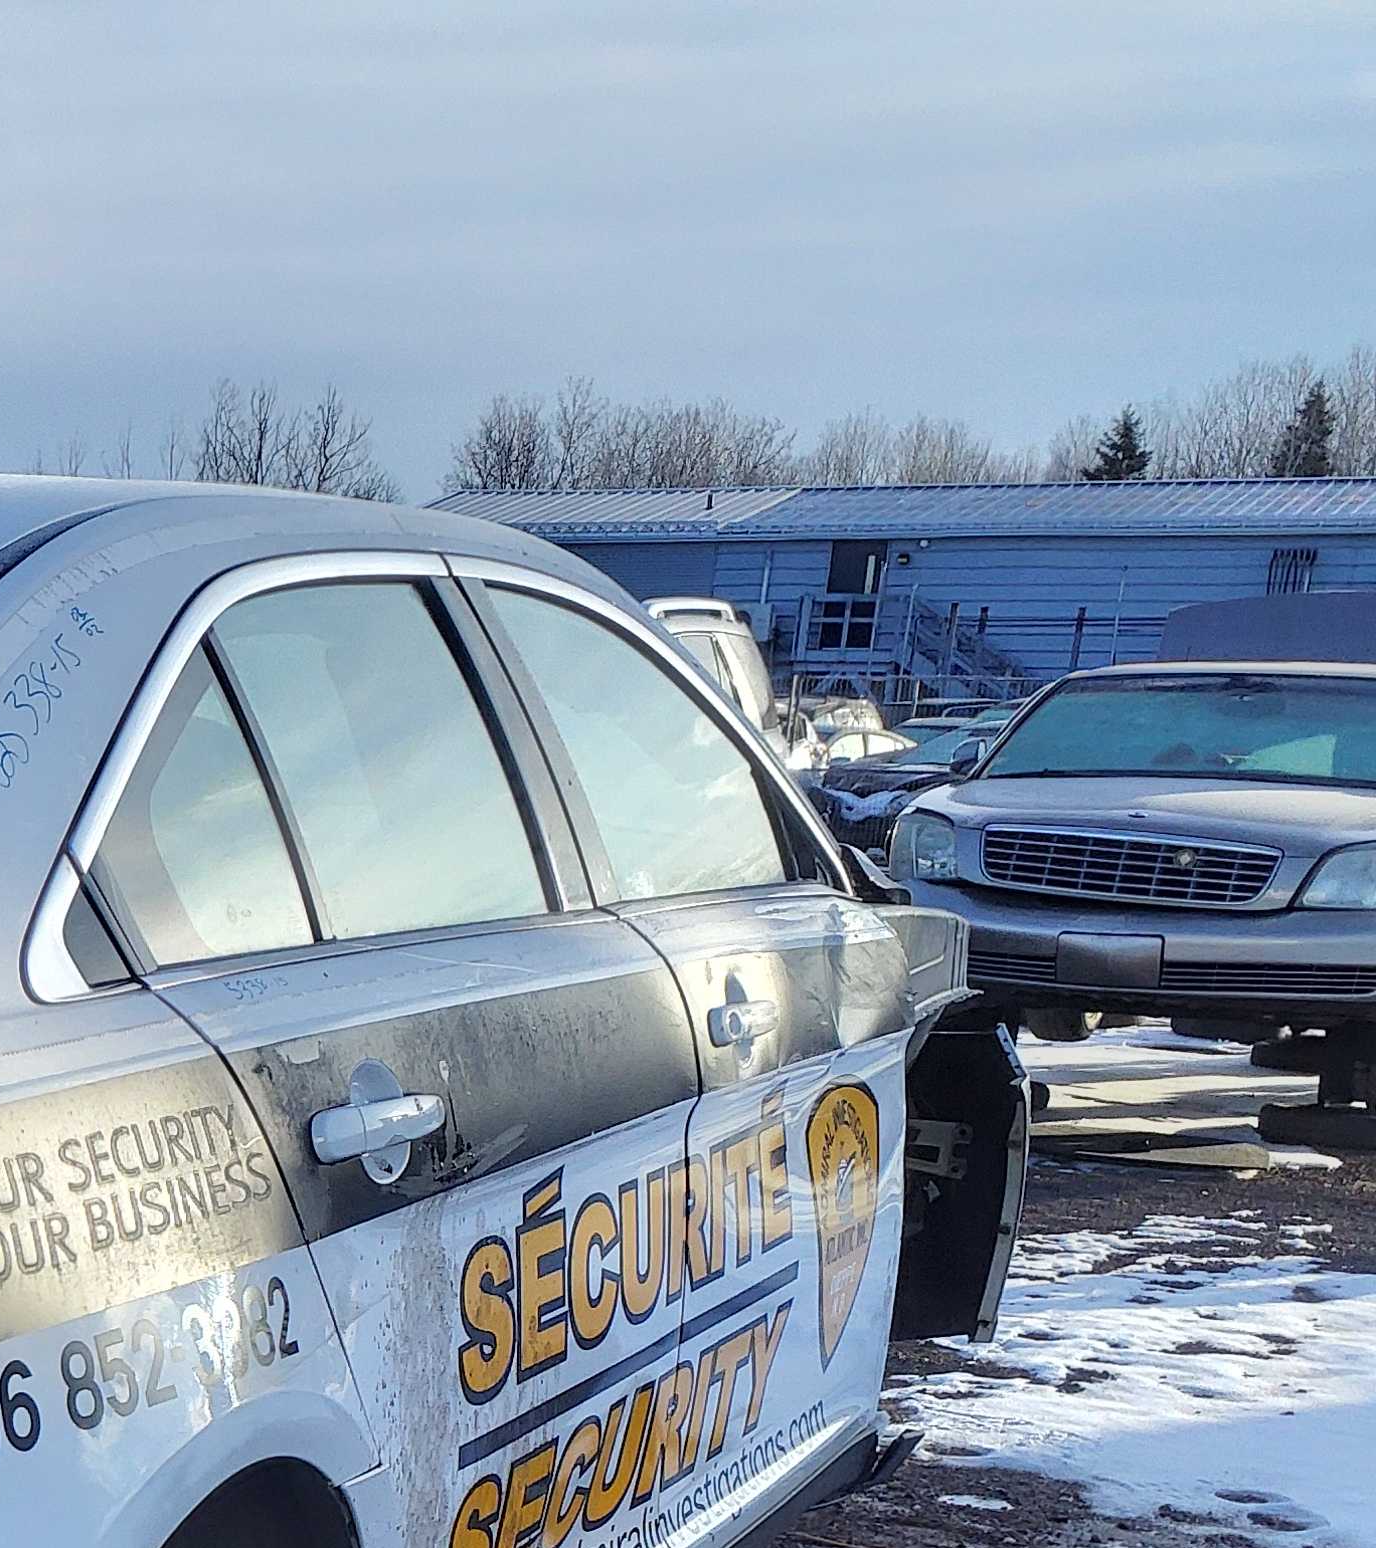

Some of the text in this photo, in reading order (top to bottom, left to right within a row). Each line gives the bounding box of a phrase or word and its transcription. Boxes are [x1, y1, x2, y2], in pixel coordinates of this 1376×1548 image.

[58, 1104, 240, 1193] SECURITY
[83, 1152, 273, 1251] BUSINESS
[457, 1079, 794, 1407] SÉCURITÉ
